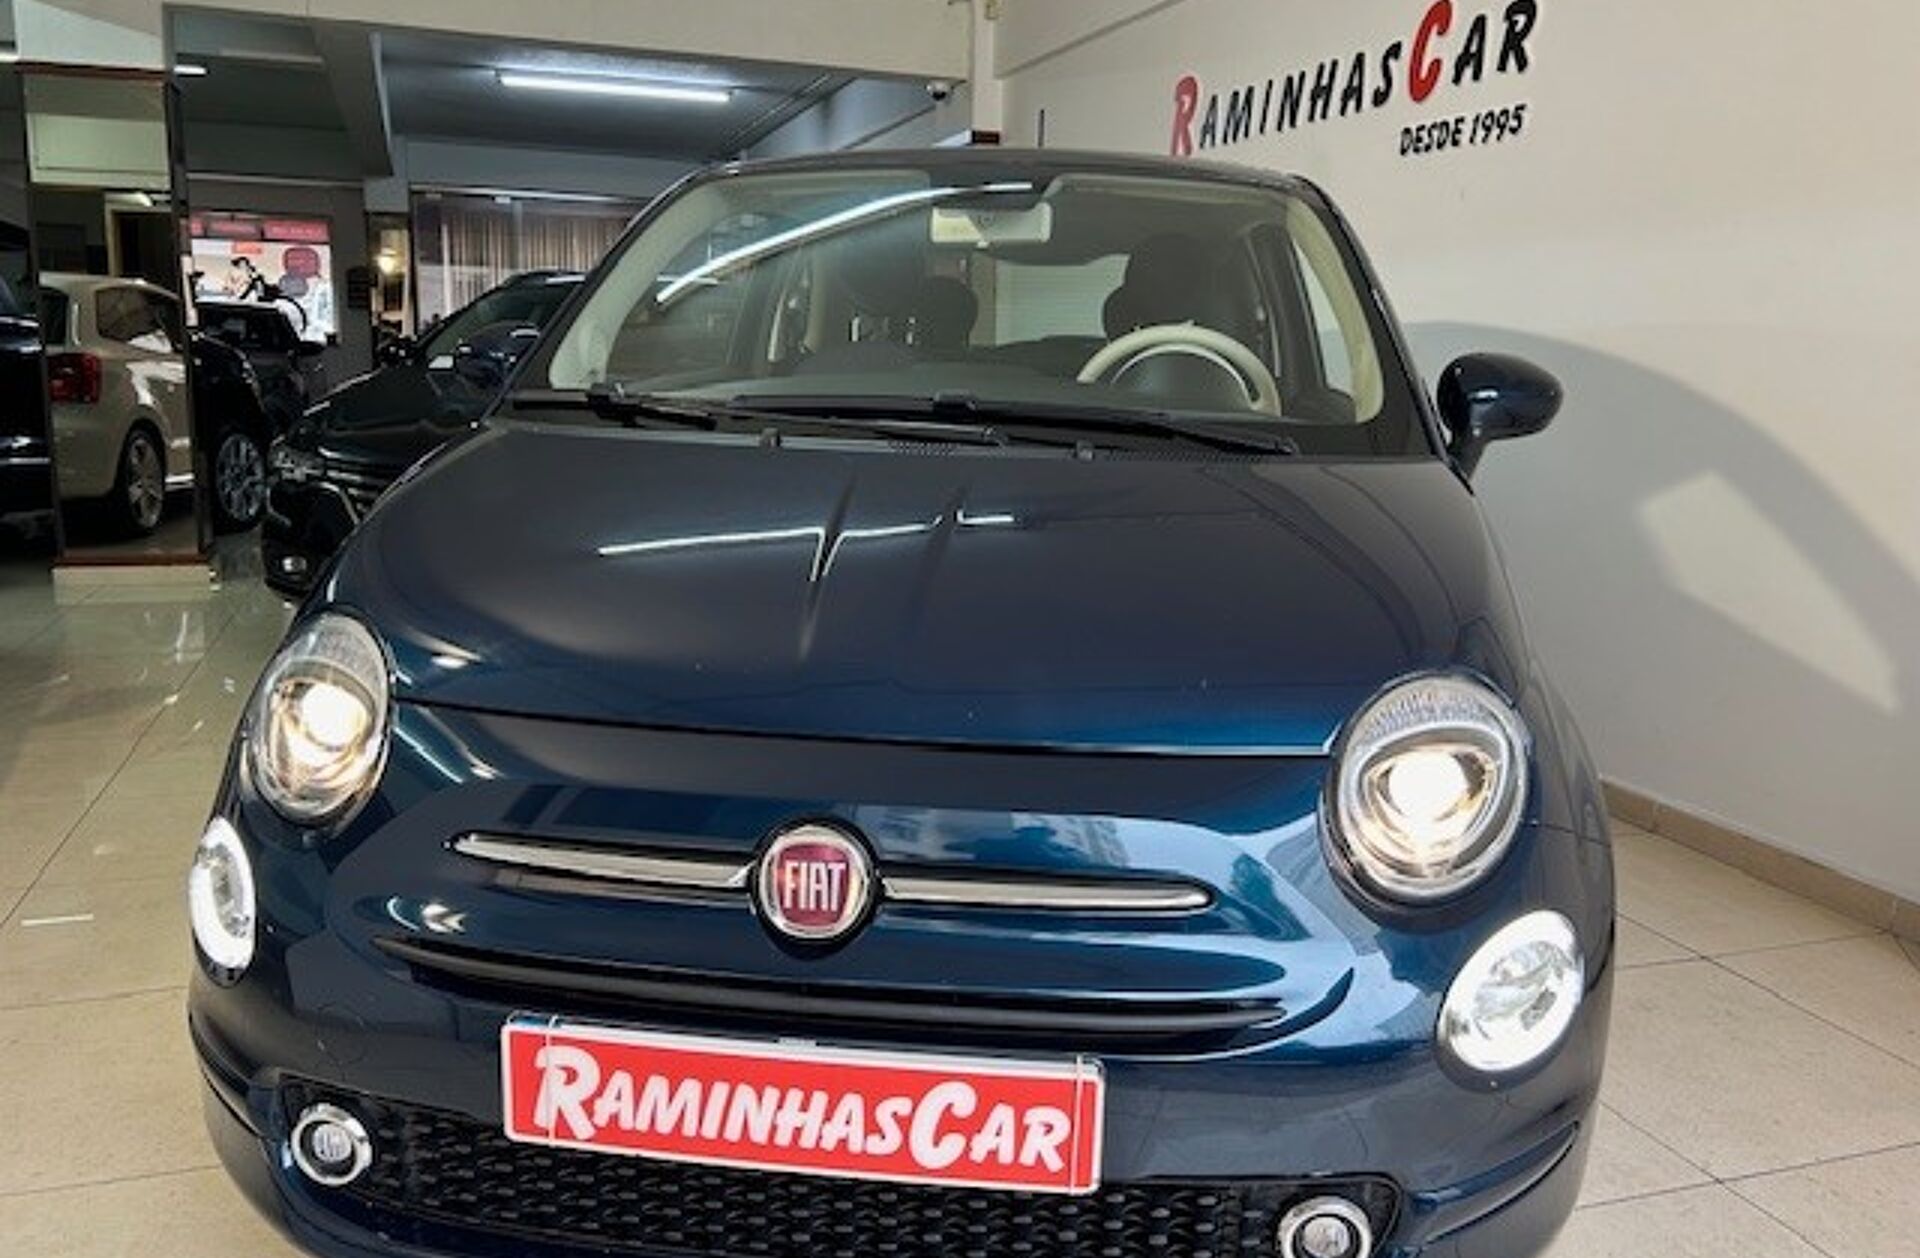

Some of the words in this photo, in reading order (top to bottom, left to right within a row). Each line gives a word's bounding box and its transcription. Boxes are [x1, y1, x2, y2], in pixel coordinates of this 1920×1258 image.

[1400, 116, 1464, 156] DESDE
[1469, 104, 1527, 146] 1995
[783, 860, 846, 912] FIAT
